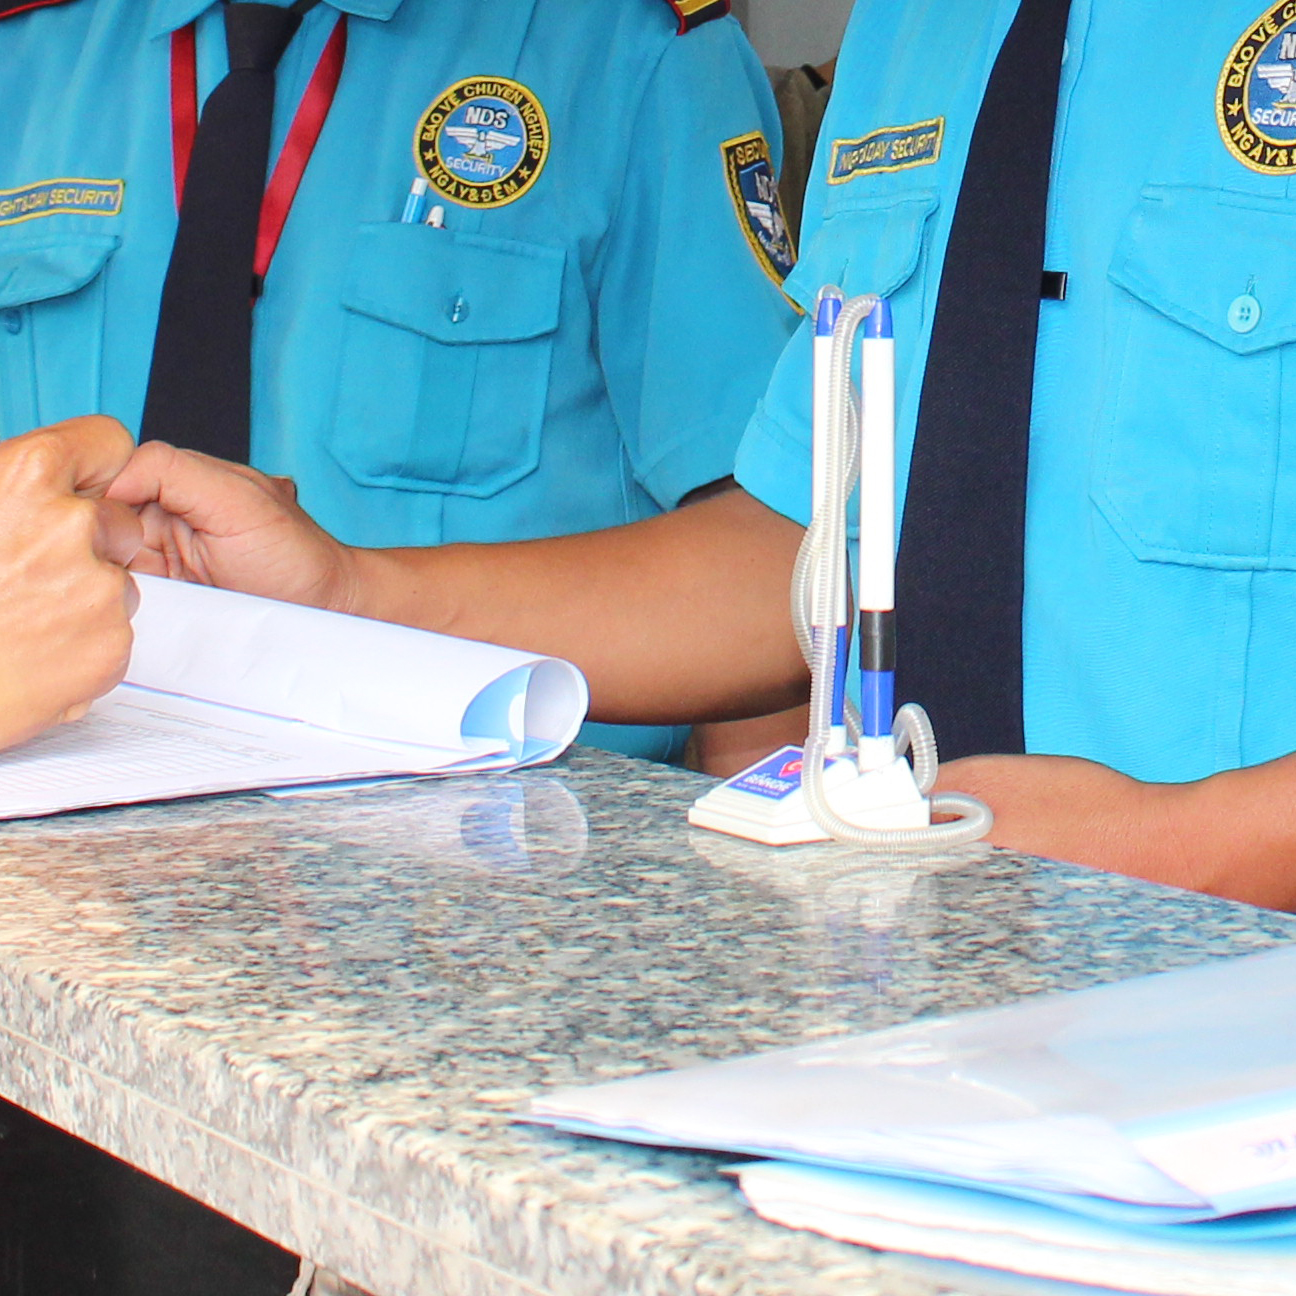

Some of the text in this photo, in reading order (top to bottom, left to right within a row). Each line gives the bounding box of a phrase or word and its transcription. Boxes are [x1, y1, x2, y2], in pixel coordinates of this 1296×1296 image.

[465, 106, 508, 129] NDS
[445, 156, 507, 177] SECURITY
[49, 188, 119, 205] SECURITY
